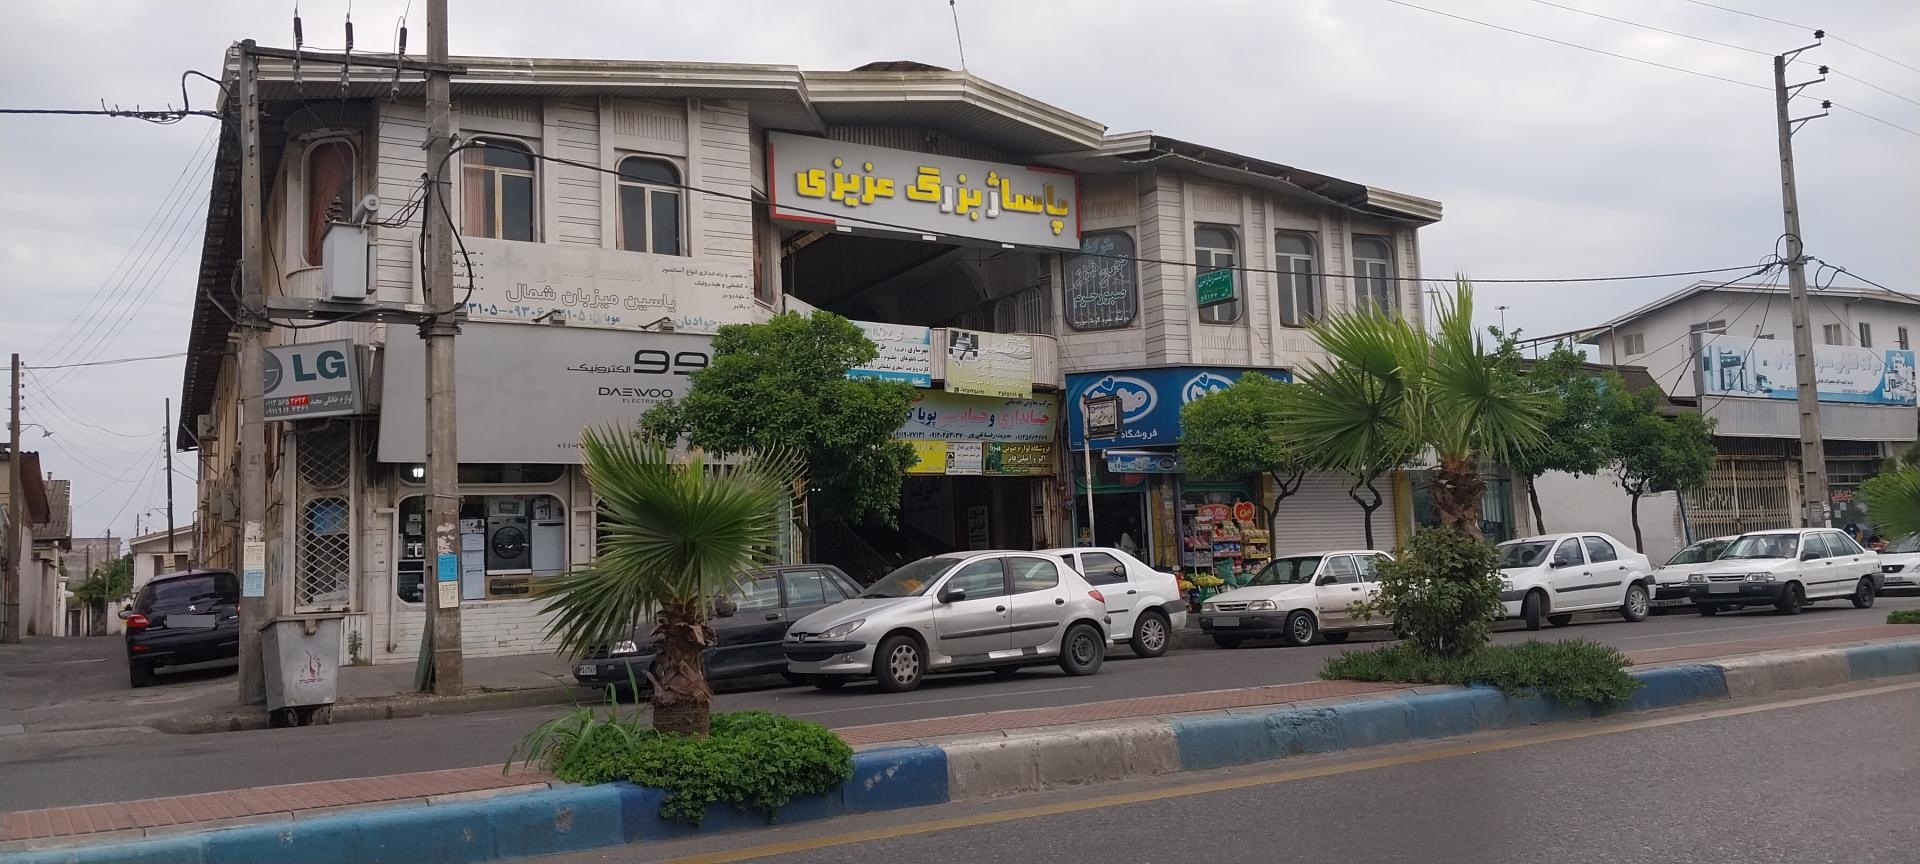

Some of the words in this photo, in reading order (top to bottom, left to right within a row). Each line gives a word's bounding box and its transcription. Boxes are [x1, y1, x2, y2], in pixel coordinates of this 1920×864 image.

[796, 157, 895, 207] عزیزی
[906, 166, 982, 221] بزرگ
[985, 170, 1069, 235] پاساژ
[505, 283, 557, 303] شمال
[561, 288, 619, 309] میزبان
[623, 294, 676, 313] یاسین
[292, 350, 347, 382] LG
[567, 363, 631, 374] الکترونیک
[598, 387, 674, 398] DAEWOO
[918, 406, 937, 427] پویا
[997, 409, 1050, 428] حسابداری
